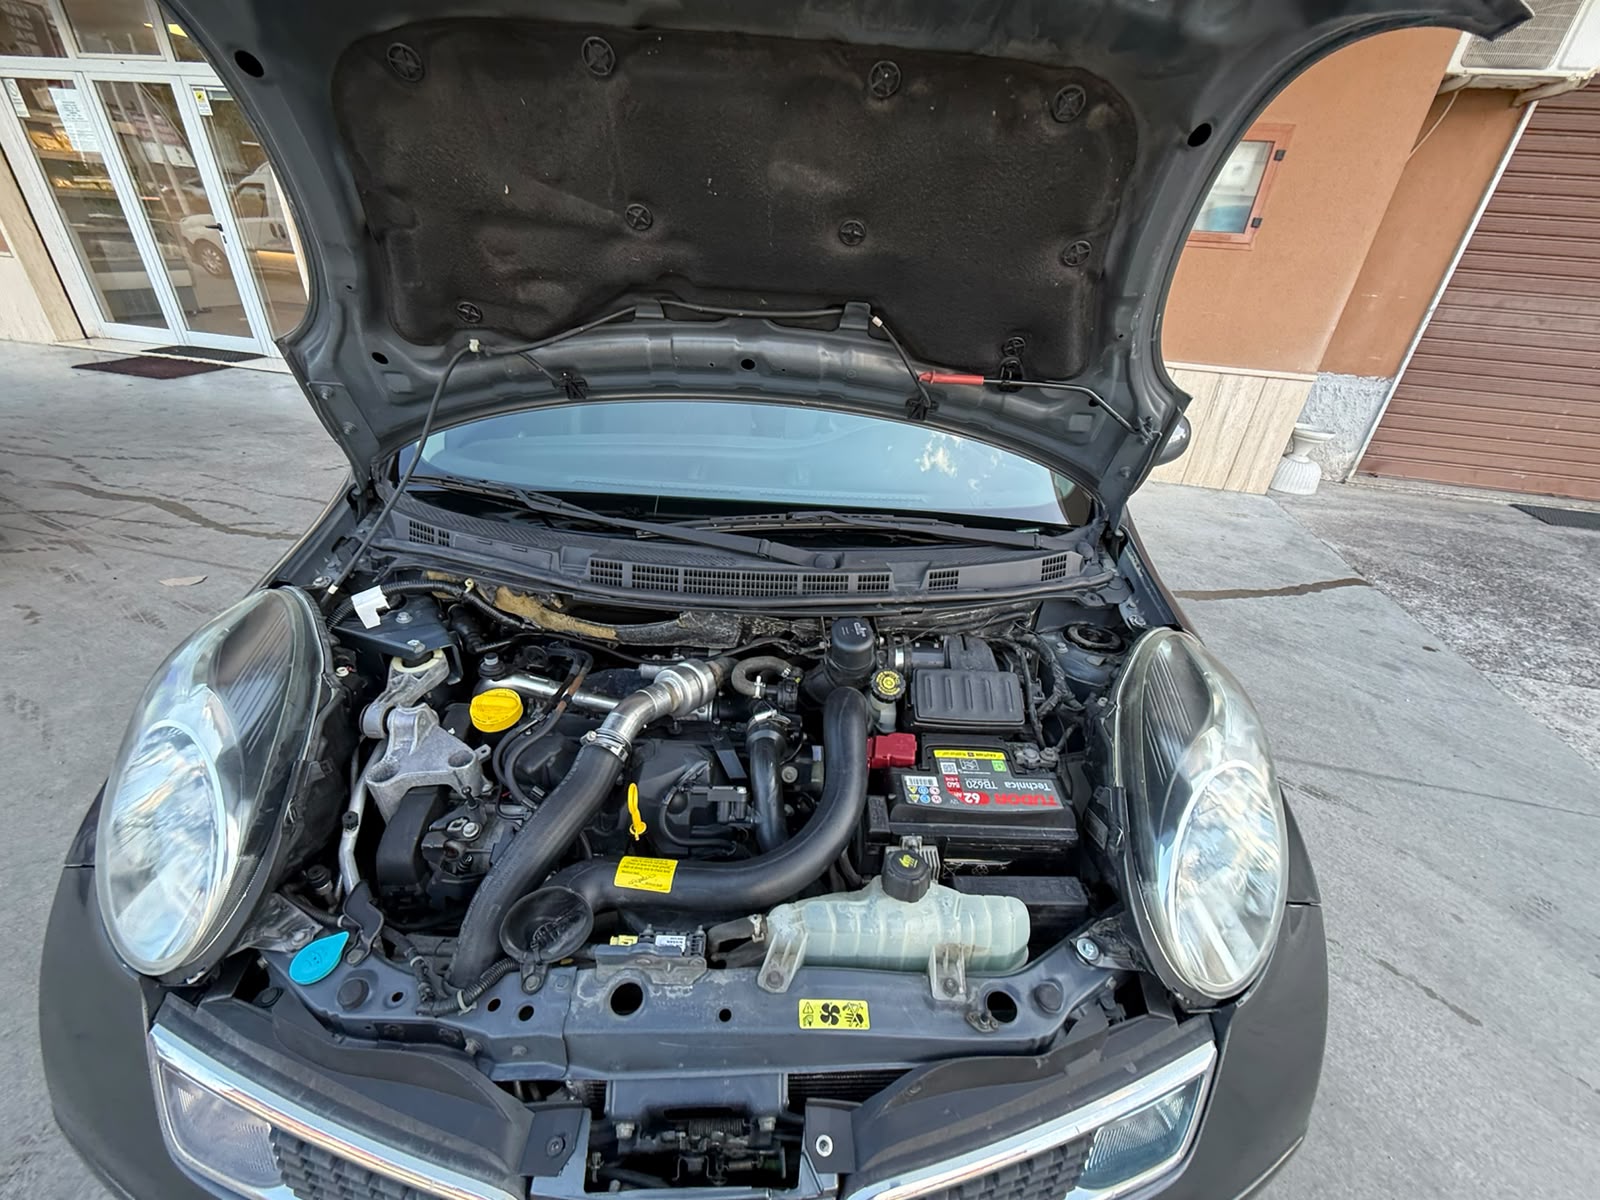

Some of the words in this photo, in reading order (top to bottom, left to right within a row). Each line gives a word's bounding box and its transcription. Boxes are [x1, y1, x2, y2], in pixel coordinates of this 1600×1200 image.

[966, 781, 998, 790] TB620
[1004, 782, 1051, 792] Technica
[963, 793, 980, 804] 62
[994, 793, 1058, 806] TUDOR
